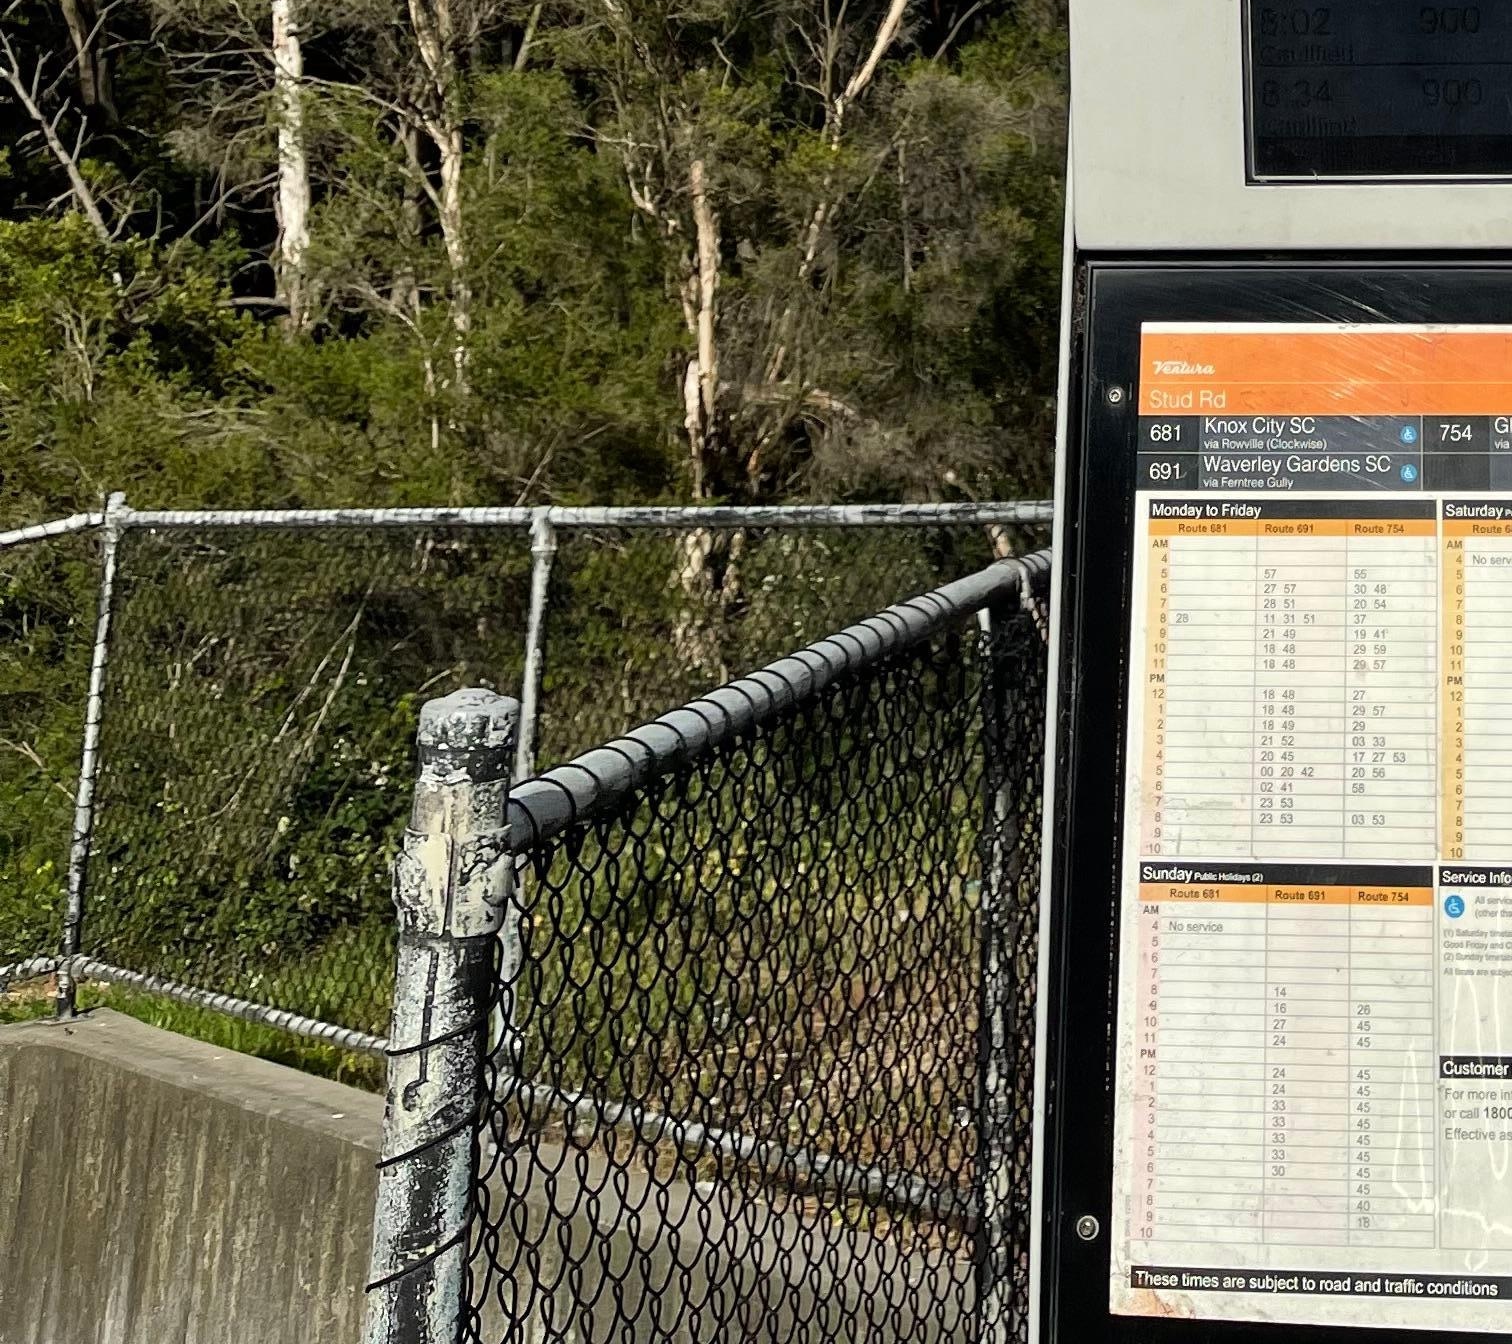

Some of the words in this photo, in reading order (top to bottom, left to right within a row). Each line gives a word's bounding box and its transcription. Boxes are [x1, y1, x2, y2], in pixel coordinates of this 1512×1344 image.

[1420, 7, 1480, 33] 900
[1422, 78, 1481, 105] 900
[1153, 361, 1215, 375] Ventura
[1150, 391, 1193, 409] Stud
[1200, 391, 1226, 408] Rd
[1150, 425, 1181, 441] 681
[1204, 418, 1247, 434] Knox
[1252, 418, 1285, 437] City
[1290, 418, 1315, 434] SC
[1440, 425, 1472, 441] 754
[1204, 440, 1219, 449] via
[1222, 439, 1264, 449] Rowville
[1267, 439, 1327, 450] (Clockwise)
[1495, 439, 1510, 448] via
[1149, 463, 1181, 480] 691
[1204, 457, 1283, 476] Waverley
[1287, 456, 1360, 472] Gardens
[1366, 456, 1391, 472] SC
[1204, 479, 1219, 487] via
[1222, 478, 1264, 488] Ferntree
[1267, 478, 1294, 489] Gully
[1152, 504, 1202, 519] Monday
[1206, 505, 1218, 516] to
[1222, 505, 1261, 519] Friday
[1446, 504, 1503, 519] Saturday
[1178, 524, 1208, 533] Route
[1210, 524, 1227, 533] 681
[1265, 525, 1294, 533] Route
[1297, 525, 1314, 533] 691
[1354, 525, 1384, 533] Route
[1387, 525, 1404, 534] 754
[1472, 526, 1502, 534] Route
[1152, 540, 1168, 548] AM
[1472, 556, 1487, 564] No
[1161, 584, 1167, 593] 6
[1264, 584, 1276, 593] 27
[1283, 584, 1296, 593] 57
[1354, 585, 1366, 594] 30
[1374, 585, 1386, 594] 48
[1160, 599, 1167, 608] 7
[1264, 599, 1276, 608] 28
[1283, 600, 1295, 608] 51
[1354, 600, 1366, 609] 20
[1374, 600, 1386, 609] 54
[1450, 692, 1462, 701] 12
[1143, 867, 1192, 882] Sunday
[1194, 873, 1217, 881] Public
[1219, 873, 1250, 882] Holidays
[1252, 873, 1263, 882] (2)
[1442, 871, 1486, 883] Service
[1170, 890, 1200, 898] Route
[1202, 890, 1219, 899] 681
[1275, 891, 1304, 900] Route
[1308, 891, 1325, 900] 691
[1358, 892, 1388, 902] Route
[1392, 892, 1409, 902] 754
[1152, 921, 1158, 930] 4
[1169, 921, 1183, 931] No
[1187, 922, 1223, 932] service
[1145, 1017, 1157, 1027] 10
[1273, 1020, 1286, 1030] 27
[1357, 1022, 1371, 1031] 45
[1443, 1062, 1510, 1076] Customer
[1444, 1089, 1464, 1100] For
[1468, 1091, 1496, 1100] more
[1445, 1109, 1457, 1118] or
[1459, 1108, 1479, 1118] call
[1445, 1129, 1496, 1140] Effective
[1500, 1132, 1512, 1141] as
[1136, 1271, 1178, 1286] These
[1181, 1273, 1219, 1287] times
[1223, 1277, 1245, 1289] are
[1250, 1275, 1298, 1292] subject
[1302, 1277, 1315, 1291] to
[1320, 1278, 1350, 1292] road
[1355, 1279, 1380, 1293] and
[1385, 1279, 1423, 1294] traffic
[1427, 1281, 1498, 1296] conditions
